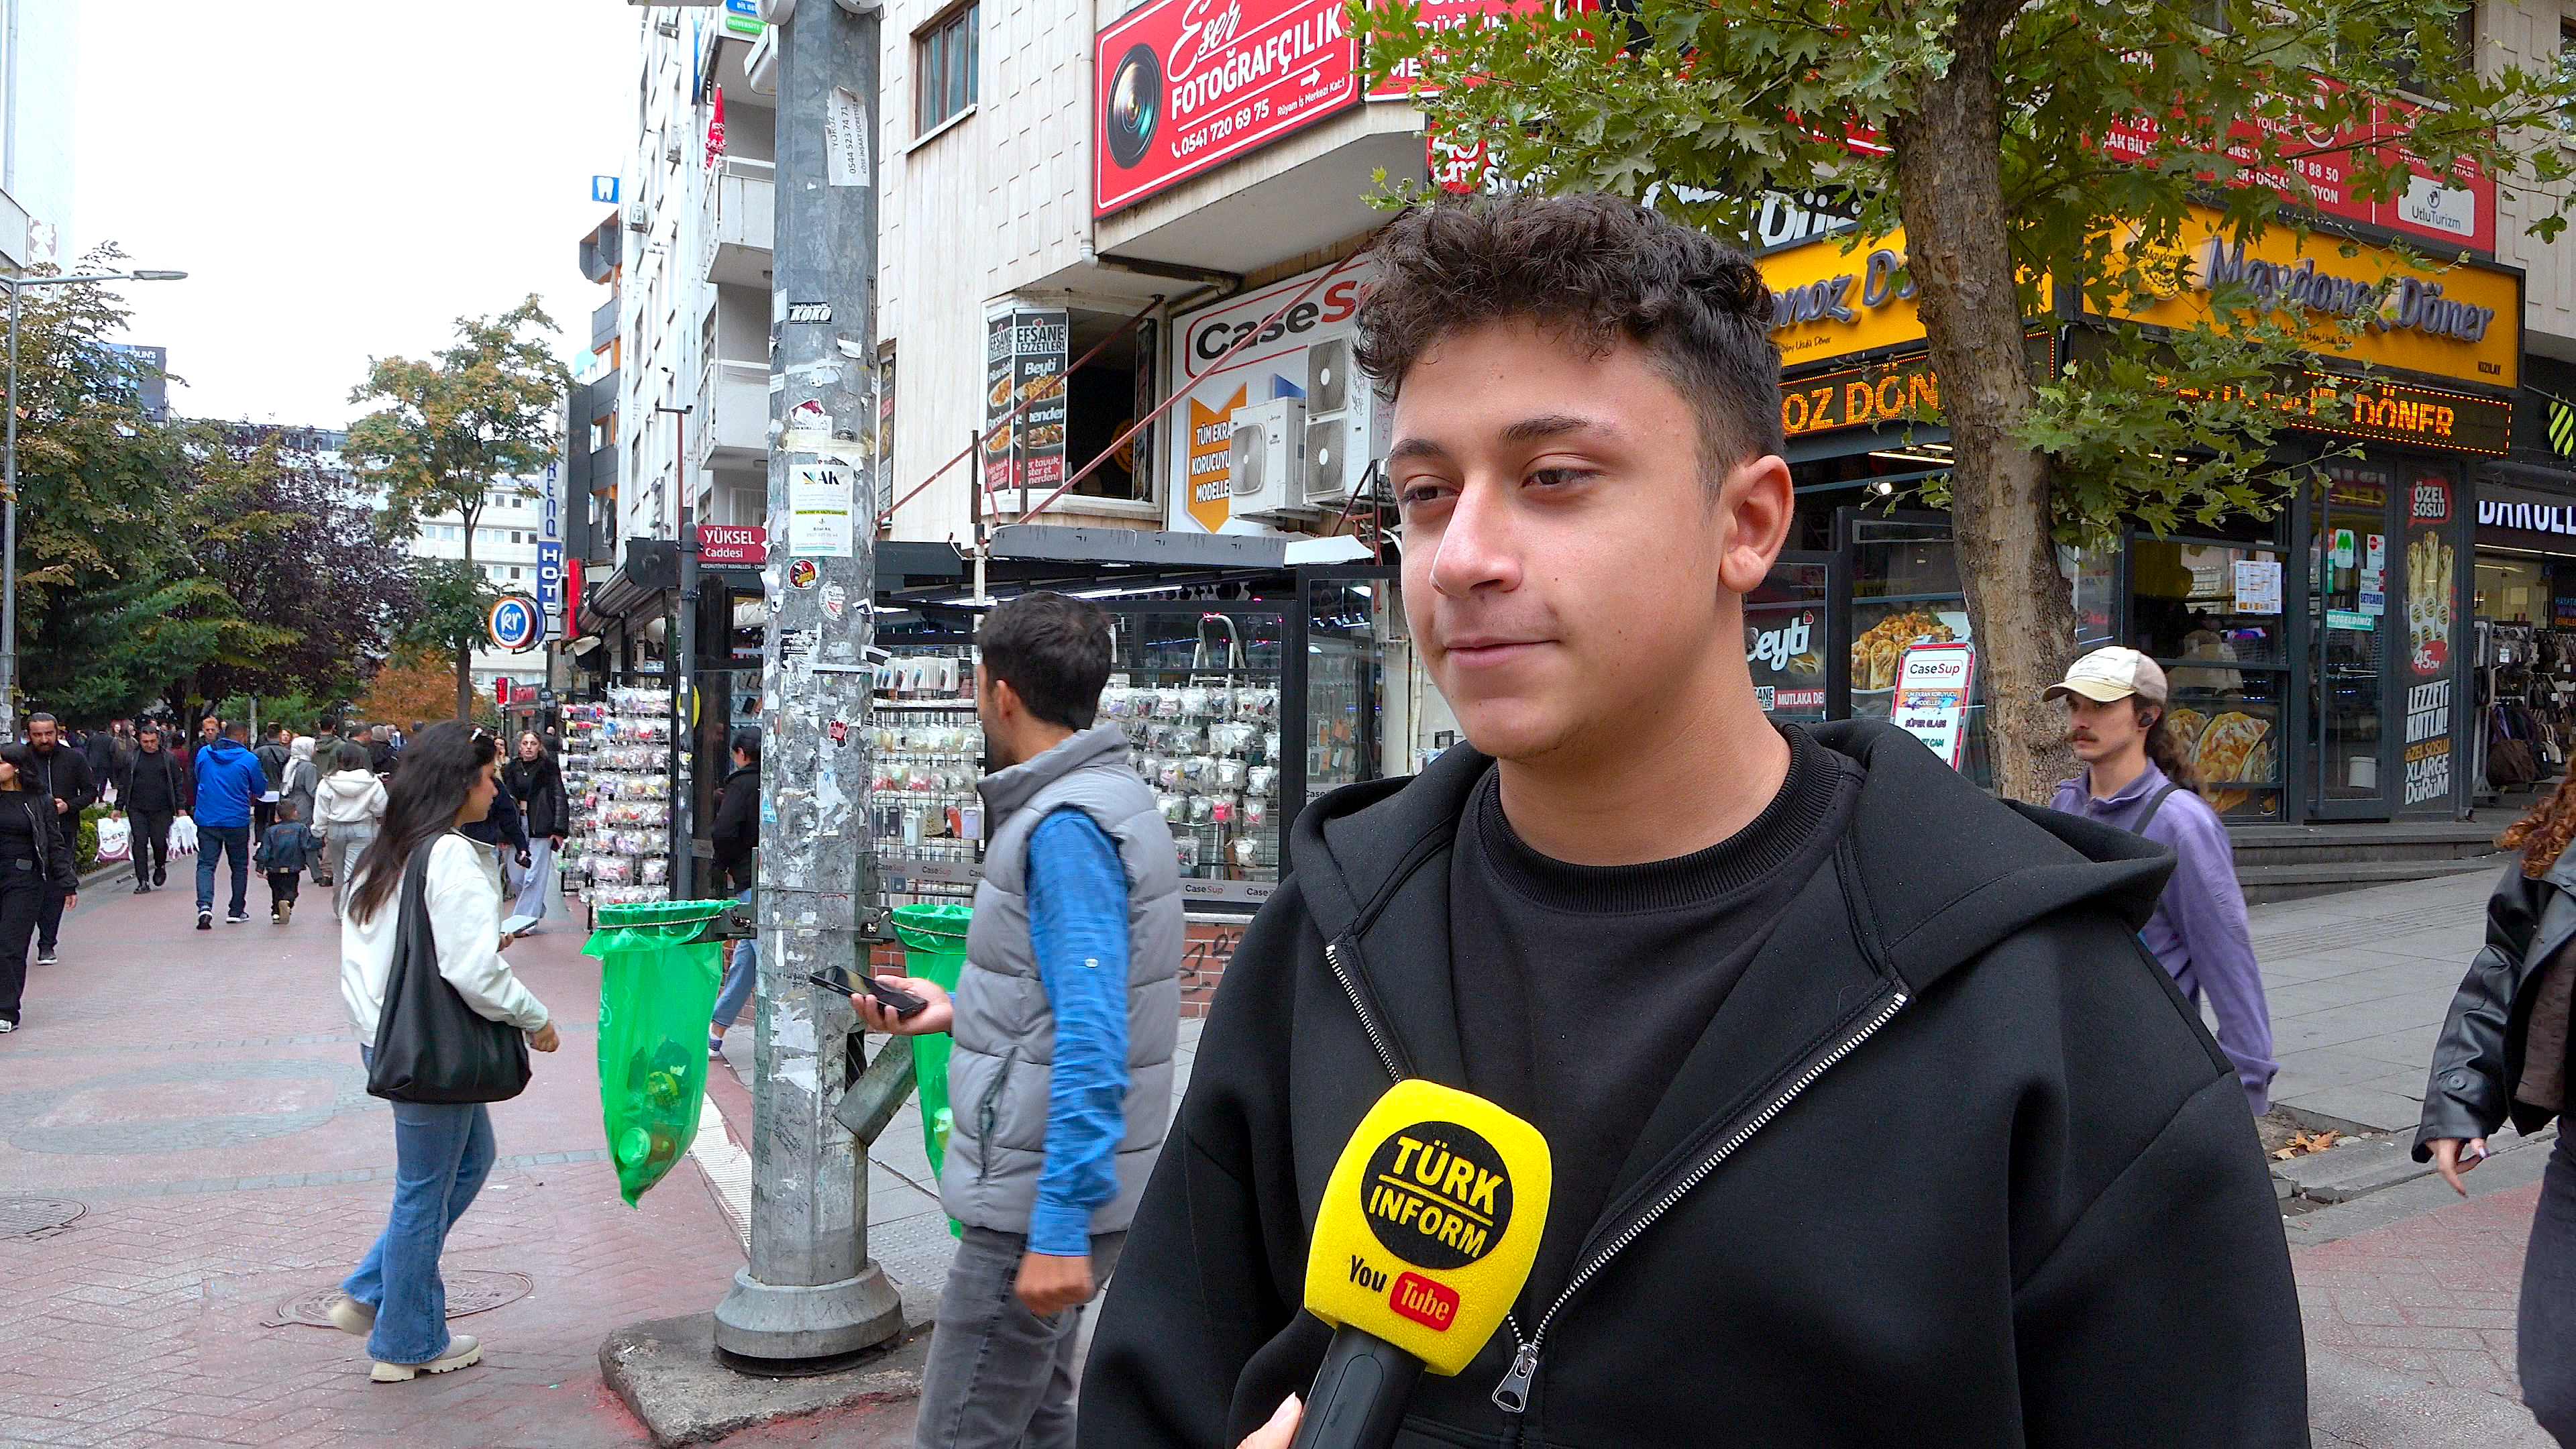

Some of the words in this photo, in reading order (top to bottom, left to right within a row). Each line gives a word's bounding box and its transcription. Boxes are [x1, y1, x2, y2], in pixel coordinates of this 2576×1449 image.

[1167, 0, 1241, 82] Eser
[1172, 1, 1342, 120] FOTOĞRAFÇILIK
[1305, 84, 1329, 104] Merkezi
[840, 106, 849, 117] 71
[842, 119, 851, 130] 74
[1181, 127, 1208, 155] 0541
[1210, 116, 1232, 142] 720
[1235, 107, 1251, 129] 69
[1253, 98, 1269, 121] 75
[844, 133, 853, 150] 523
[847, 152, 857, 174] 0544
[2309, 162, 2322, 178] 88
[2326, 166, 2339, 183] 50
[2412, 205, 2461, 229] UtluTurizm
[790, 308, 833, 322] KOKO
[2398, 275, 2496, 343] Döner
[1196, 280, 1363, 360] CaseS
[1016, 326, 1065, 343] EFSANE
[1016, 341, 1065, 354] LEZZETLER!
[1024, 358, 1057, 377] Beyti
[1196, 422, 1212, 447] TÜM
[2414, 480, 2445, 503] ÖZEL
[2412, 502, 2445, 517] SOSLU
[704, 527, 755, 545] YÜKSEL
[705, 547, 744, 558] Caddesi
[1910, 663, 1960, 676] CaseSup
[1778, 692, 1812, 706] MUTLAKA
[2407, 678, 2450, 716] LEZZETİ
[2405, 753, 2449, 782] XLARGE
[2404, 774, 2449, 806] DÜRÜM
[922, 866, 952, 875] CaseSup
[1185, 884, 1224, 894] CaseSup
[1391, 1135, 1504, 1215] TÜRK
[1368, 1185, 1487, 1258] INFORM
[1350, 1254, 1387, 1293] You
[1400, 1279, 1450, 1321] Tube
